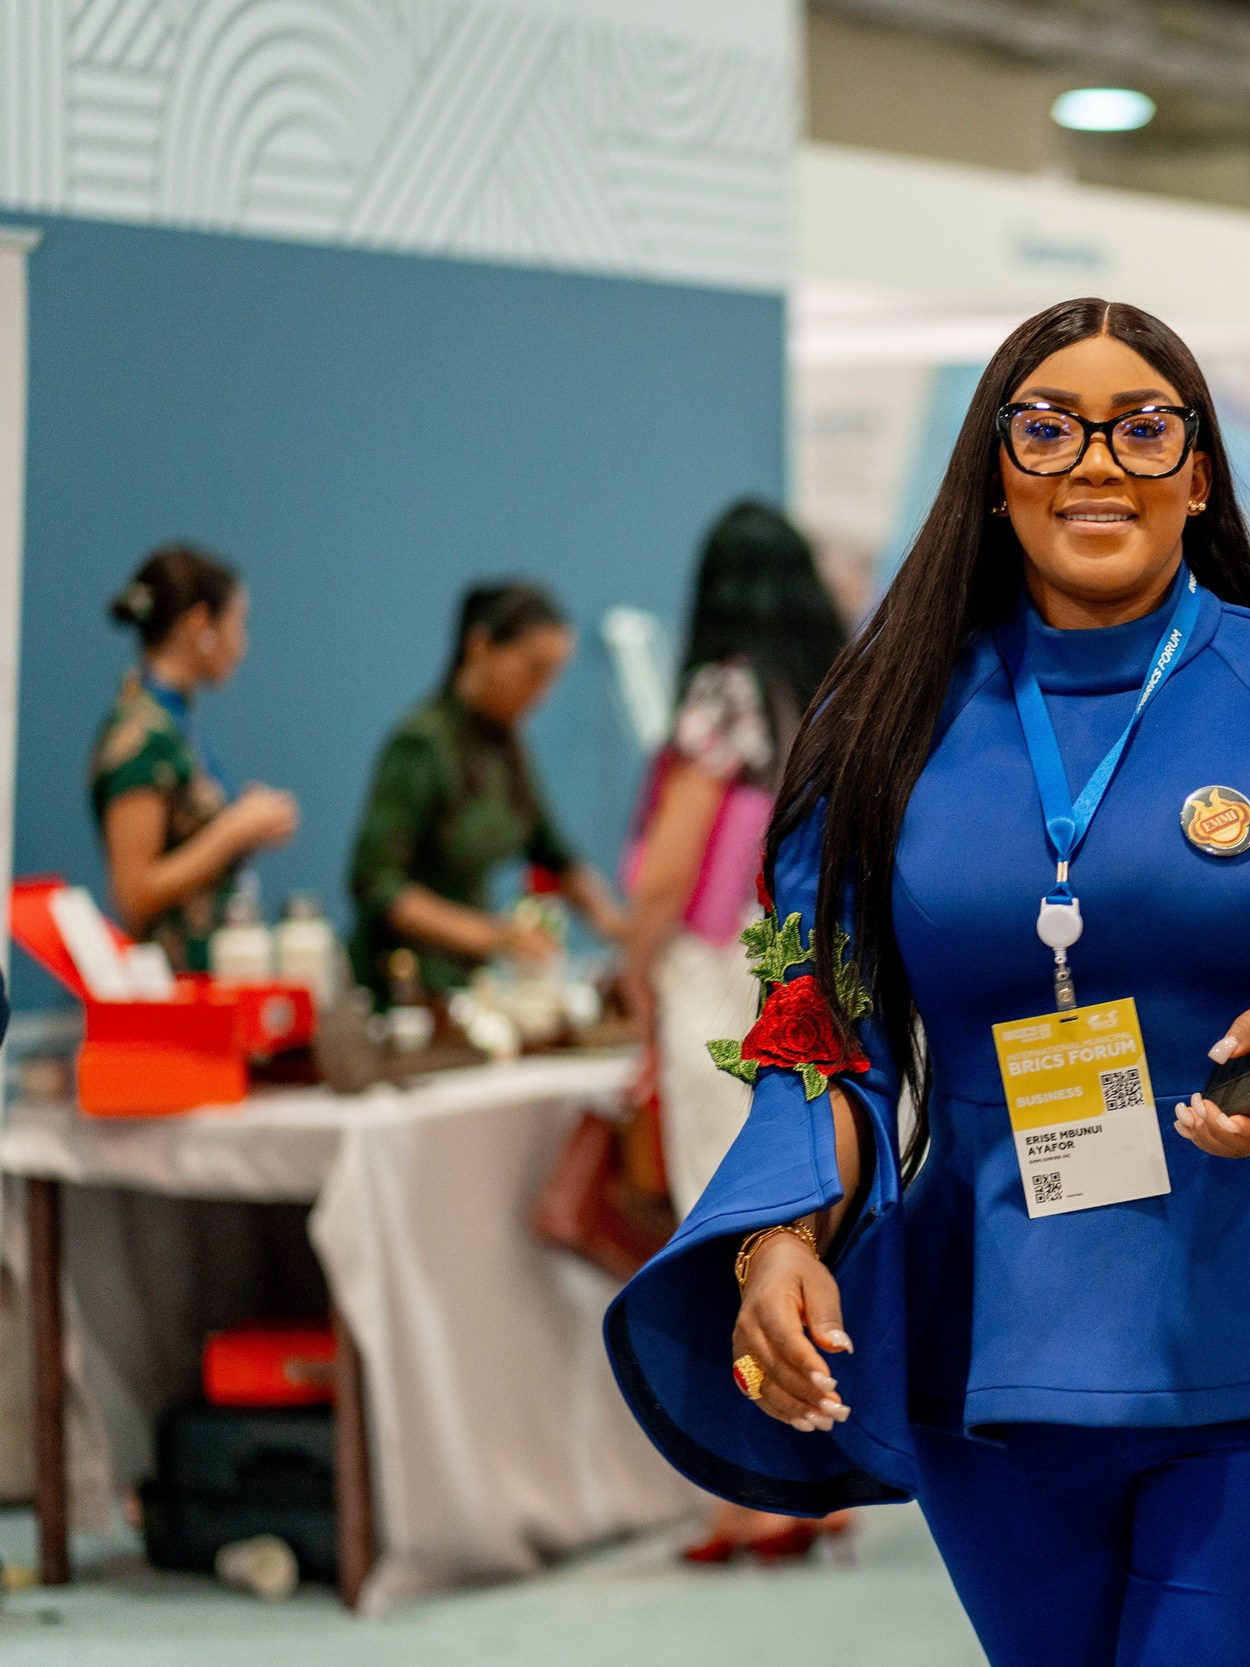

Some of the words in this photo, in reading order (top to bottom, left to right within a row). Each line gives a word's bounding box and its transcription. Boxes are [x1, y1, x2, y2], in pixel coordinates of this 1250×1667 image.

[1157, 628, 1183, 670] FORUM
[1008, 1052, 1065, 1077] BRICS
[1067, 1038, 1137, 1065] FORUM
[1015, 1085, 1084, 1107] BUSINESS
[1025, 1132, 1058, 1145] ERISE
[1060, 1125, 1103, 1140] MBUNUI
[1027, 1140, 1075, 1156] AYAFOR
